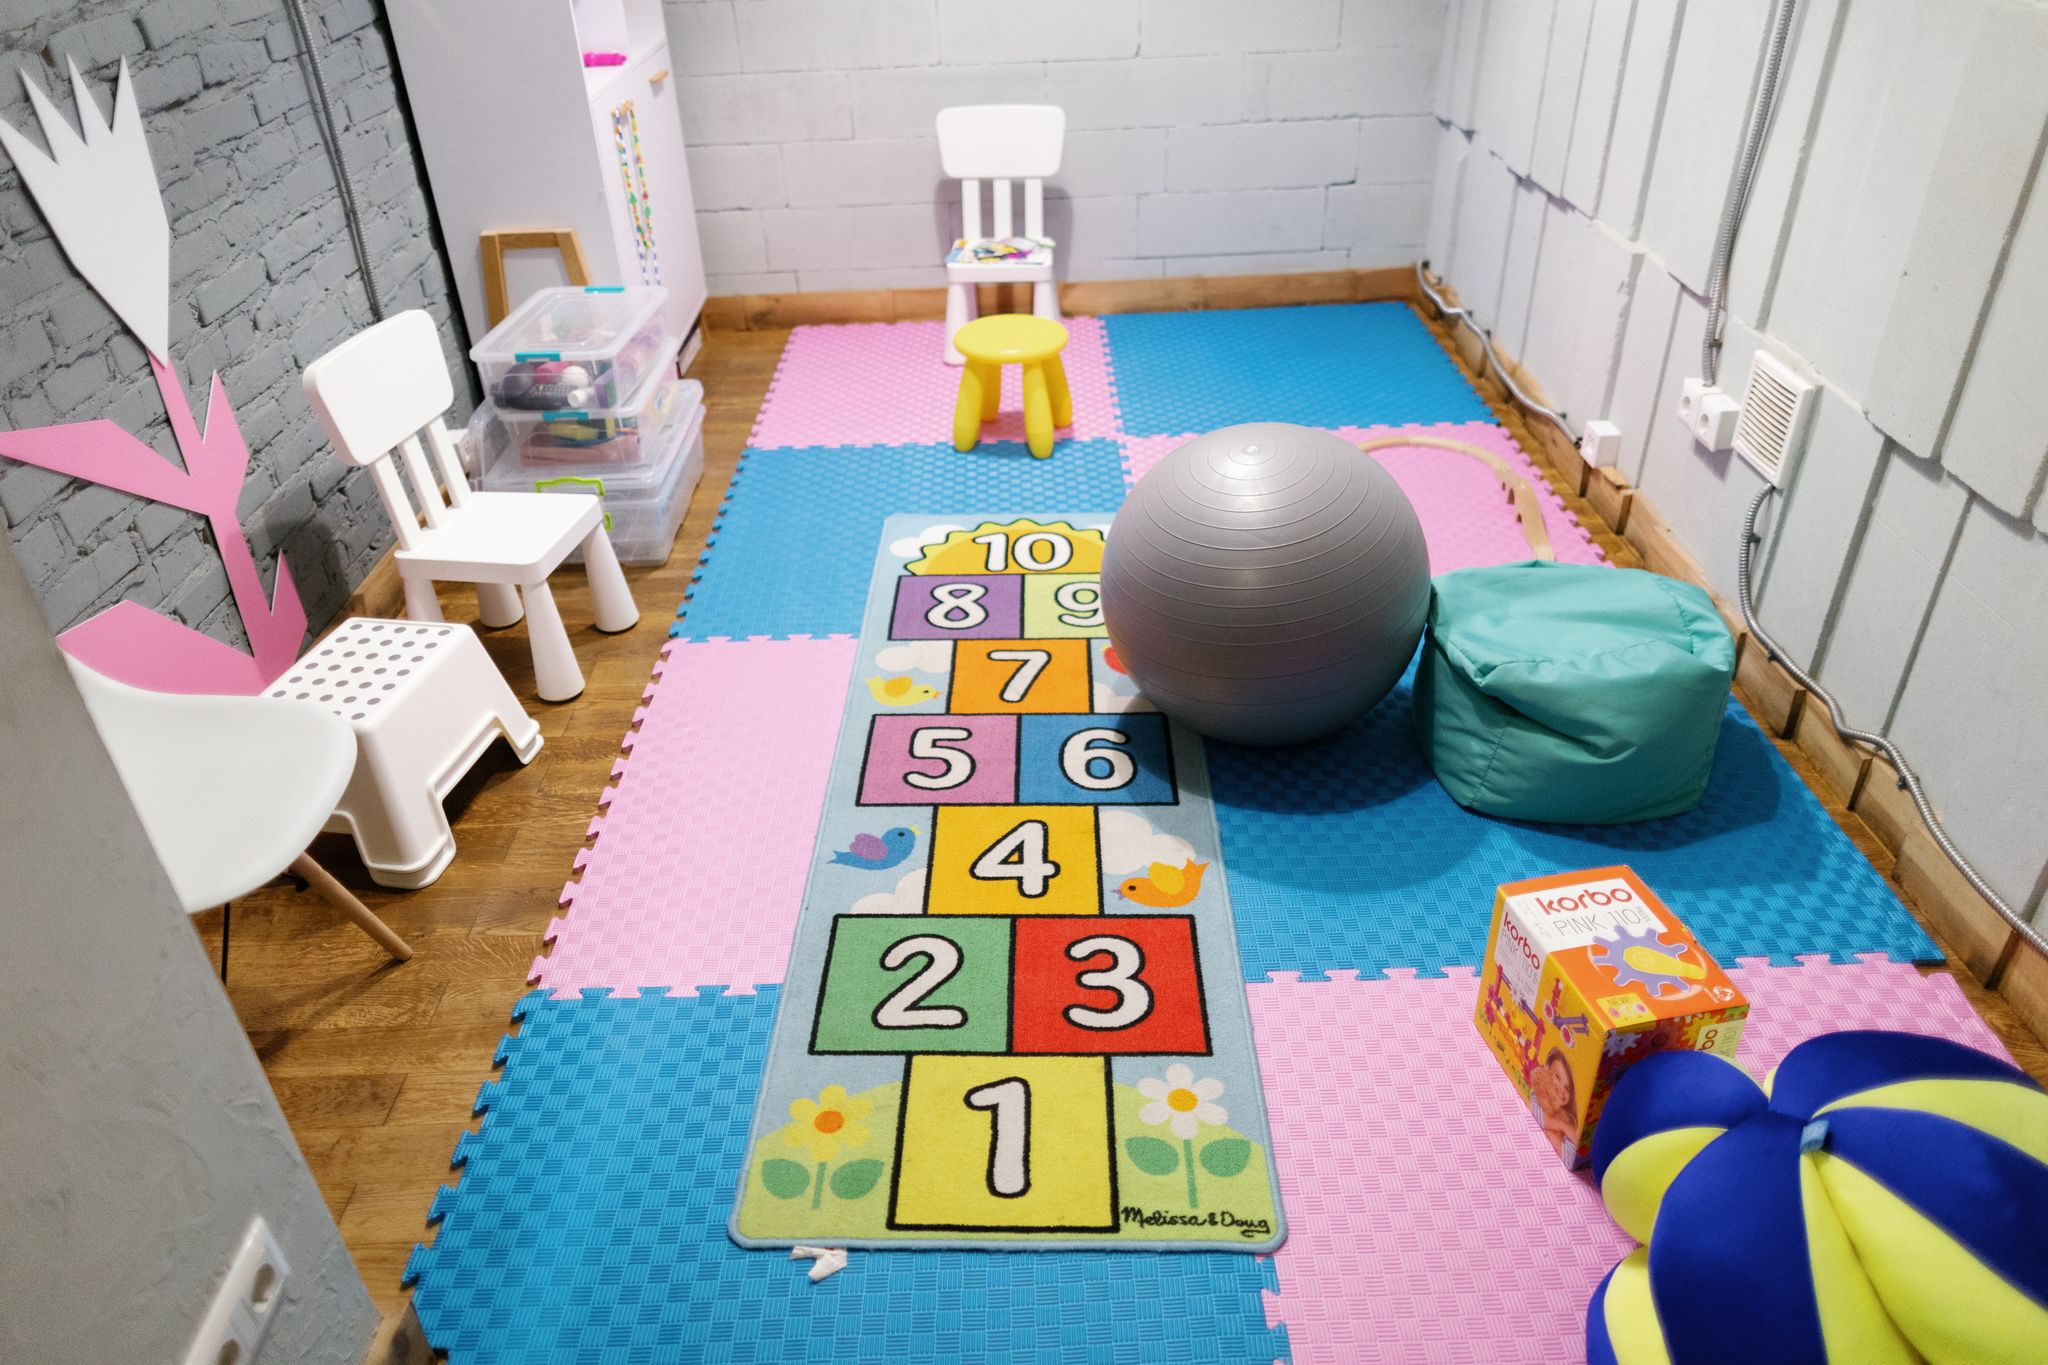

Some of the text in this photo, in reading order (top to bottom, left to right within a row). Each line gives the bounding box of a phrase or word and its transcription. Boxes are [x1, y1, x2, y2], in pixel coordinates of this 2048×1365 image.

[972, 532, 1073, 572] 10
[925, 582, 989, 629] 8
[1055, 581, 1108, 627] 9
[987, 649, 1051, 703] 7
[903, 726, 976, 791] 5
[1059, 727, 1137, 791] 6
[969, 819, 1060, 898] 4
[1535, 888, 1632, 915] korbo
[1553, 912, 1607, 936] PINK
[1503, 912, 1540, 970] korbo
[872, 933, 968, 1030] 2
[1062, 934, 1155, 1031] 3
[964, 1076, 1031, 1198] 1
[1121, 1206, 1207, 1228] Melissa
[1220, 1211, 1271, 1238] Doug
